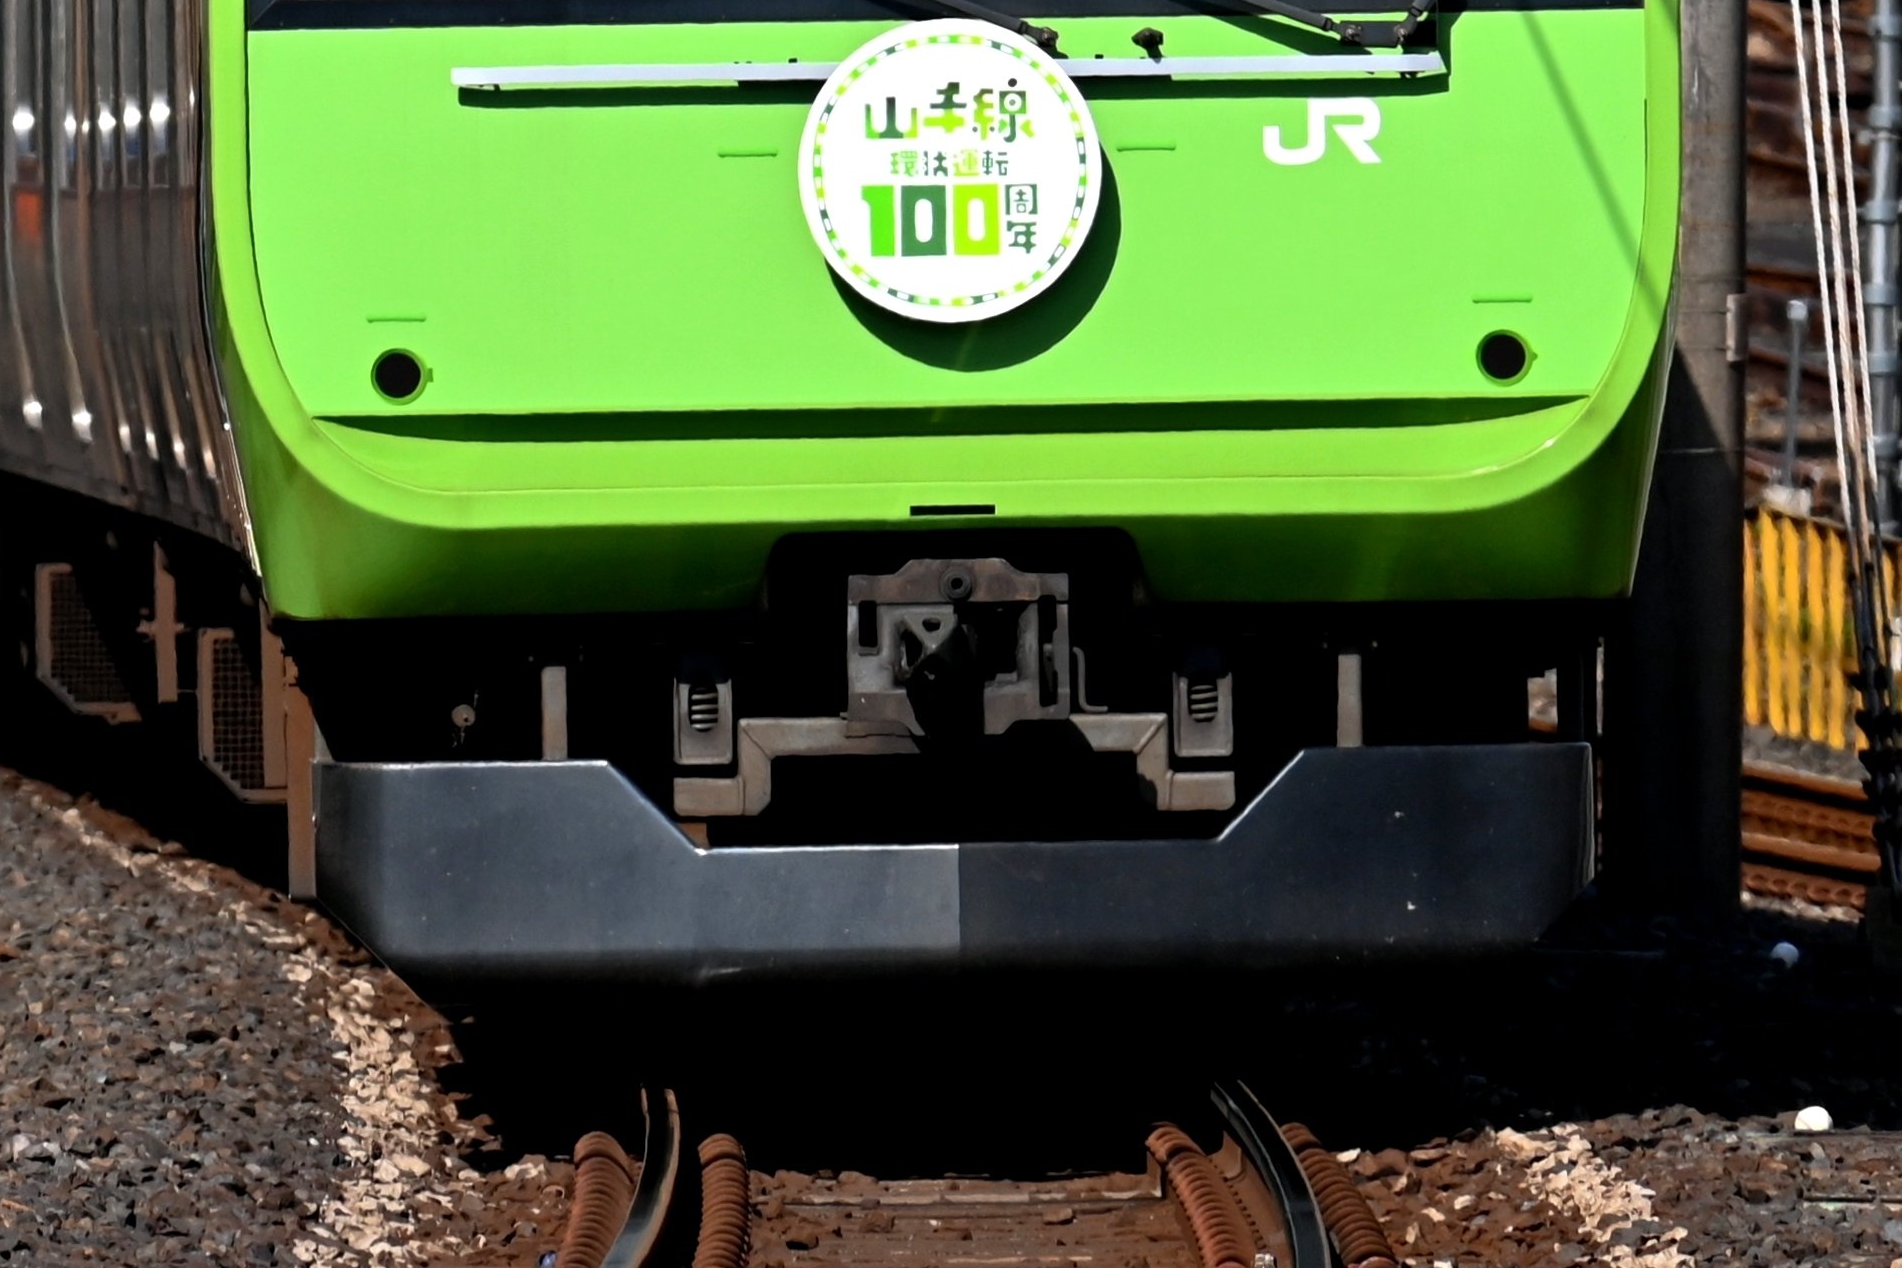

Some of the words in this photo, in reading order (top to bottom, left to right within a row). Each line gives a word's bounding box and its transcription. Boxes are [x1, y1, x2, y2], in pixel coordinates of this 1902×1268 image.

[864, 78, 1036, 143] 山手線
[1262, 96, 1382, 166] JR
[889, 148, 1009, 177] 環状運転
[861, 183, 1001, 257] 100
